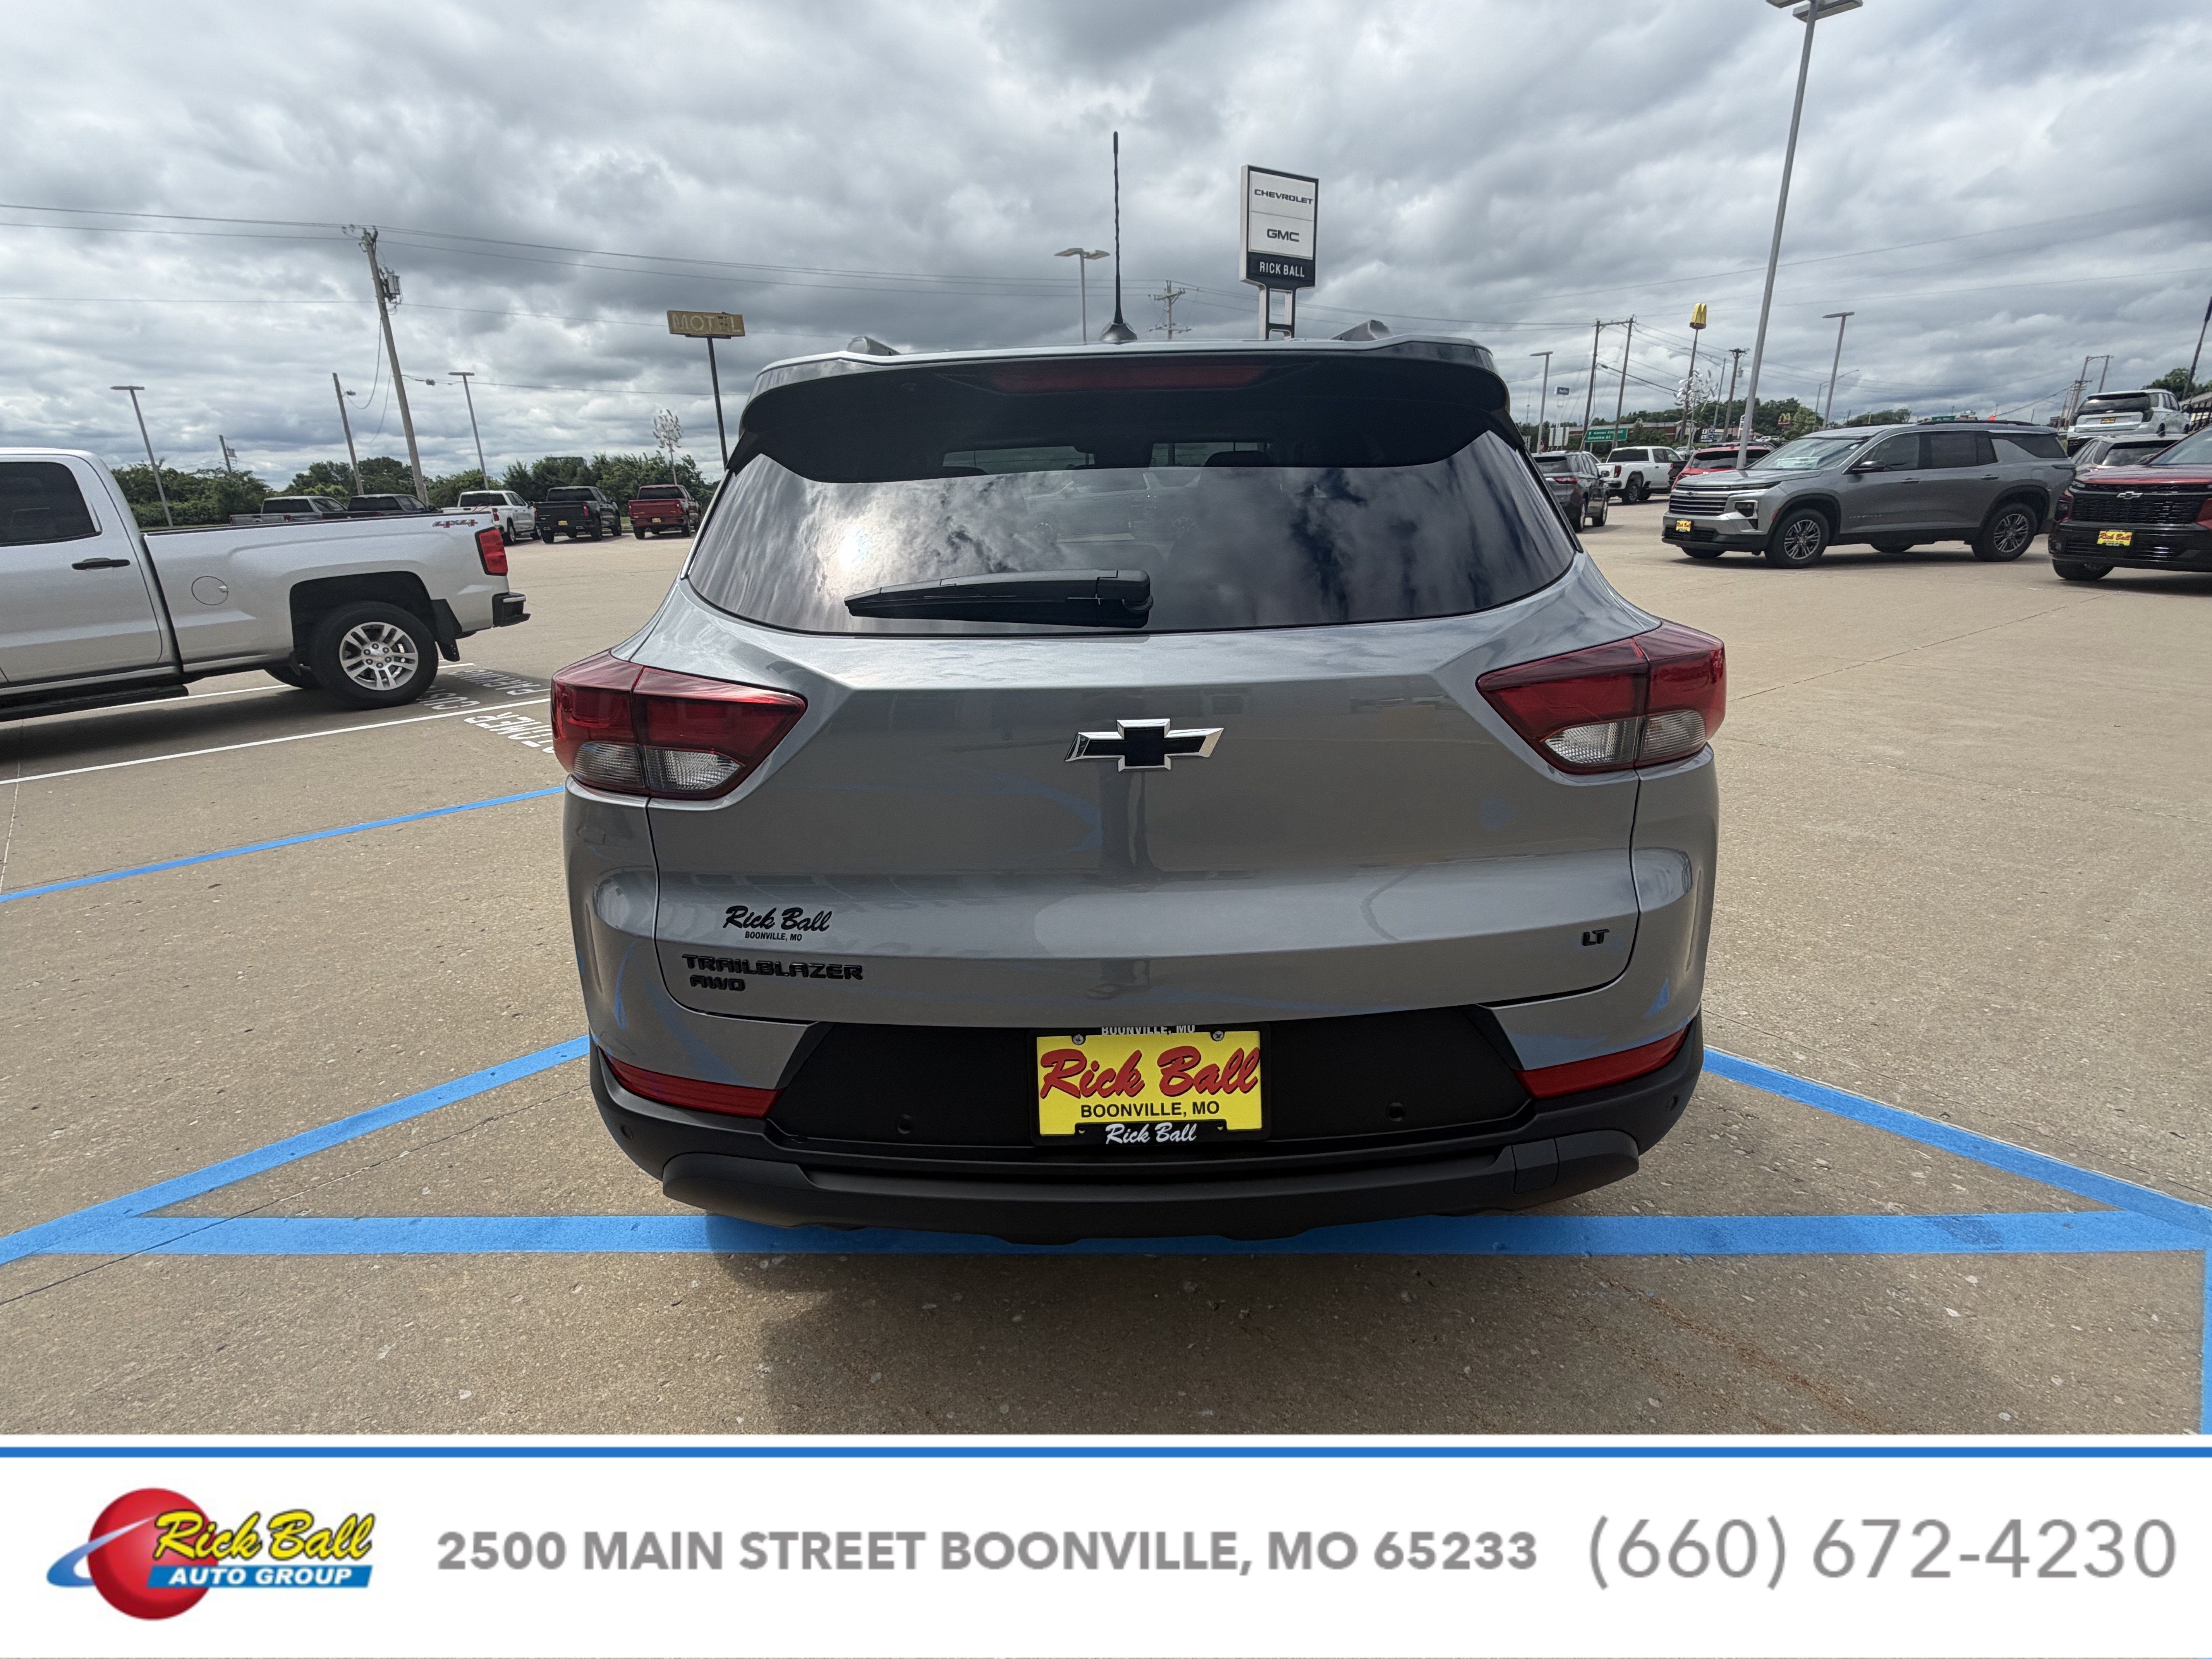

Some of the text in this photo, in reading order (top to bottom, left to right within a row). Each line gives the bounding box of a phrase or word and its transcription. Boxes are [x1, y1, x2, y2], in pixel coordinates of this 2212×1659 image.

[1254, 189, 1314, 204] CHEVROLET
[1266, 228, 1300, 242] GMC
[1259, 261, 1305, 278] RICK BALL
[672, 313, 742, 333] MOTEL
[723, 905, 833, 932] Rick Ball
[745, 931, 802, 942] BOONVILLE, MO
[1582, 928, 1610, 946] LT
[682, 953, 863, 980] TRAILBLAZER
[689, 974, 746, 992] AWD
[1040, 1046, 1259, 1099] Rick Ball
[1080, 1101, 1219, 1118] BOONVILLE, MO
[1105, 1123, 1197, 1144] Rick Ball
